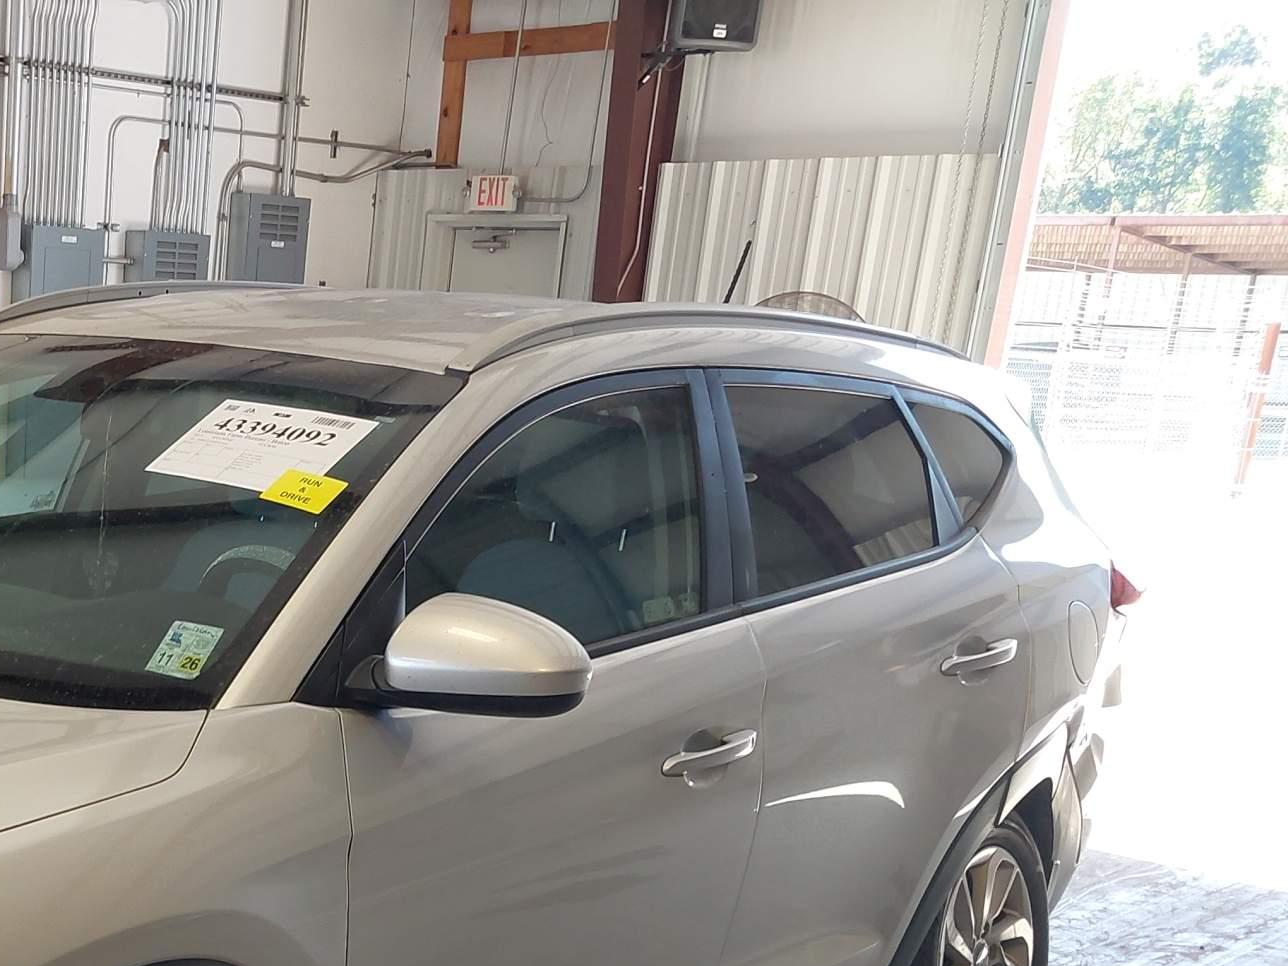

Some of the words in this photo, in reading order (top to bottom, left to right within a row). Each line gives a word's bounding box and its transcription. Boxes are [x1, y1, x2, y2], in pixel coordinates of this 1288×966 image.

[477, 176, 509, 207] EXIT
[215, 417, 337, 447] 43394092
[298, 486, 306, 494] &
[299, 476, 323, 488] RUN
[280, 490, 312, 504] DRIVE
[158, 651, 174, 666] 11
[180, 656, 201, 671] 26
